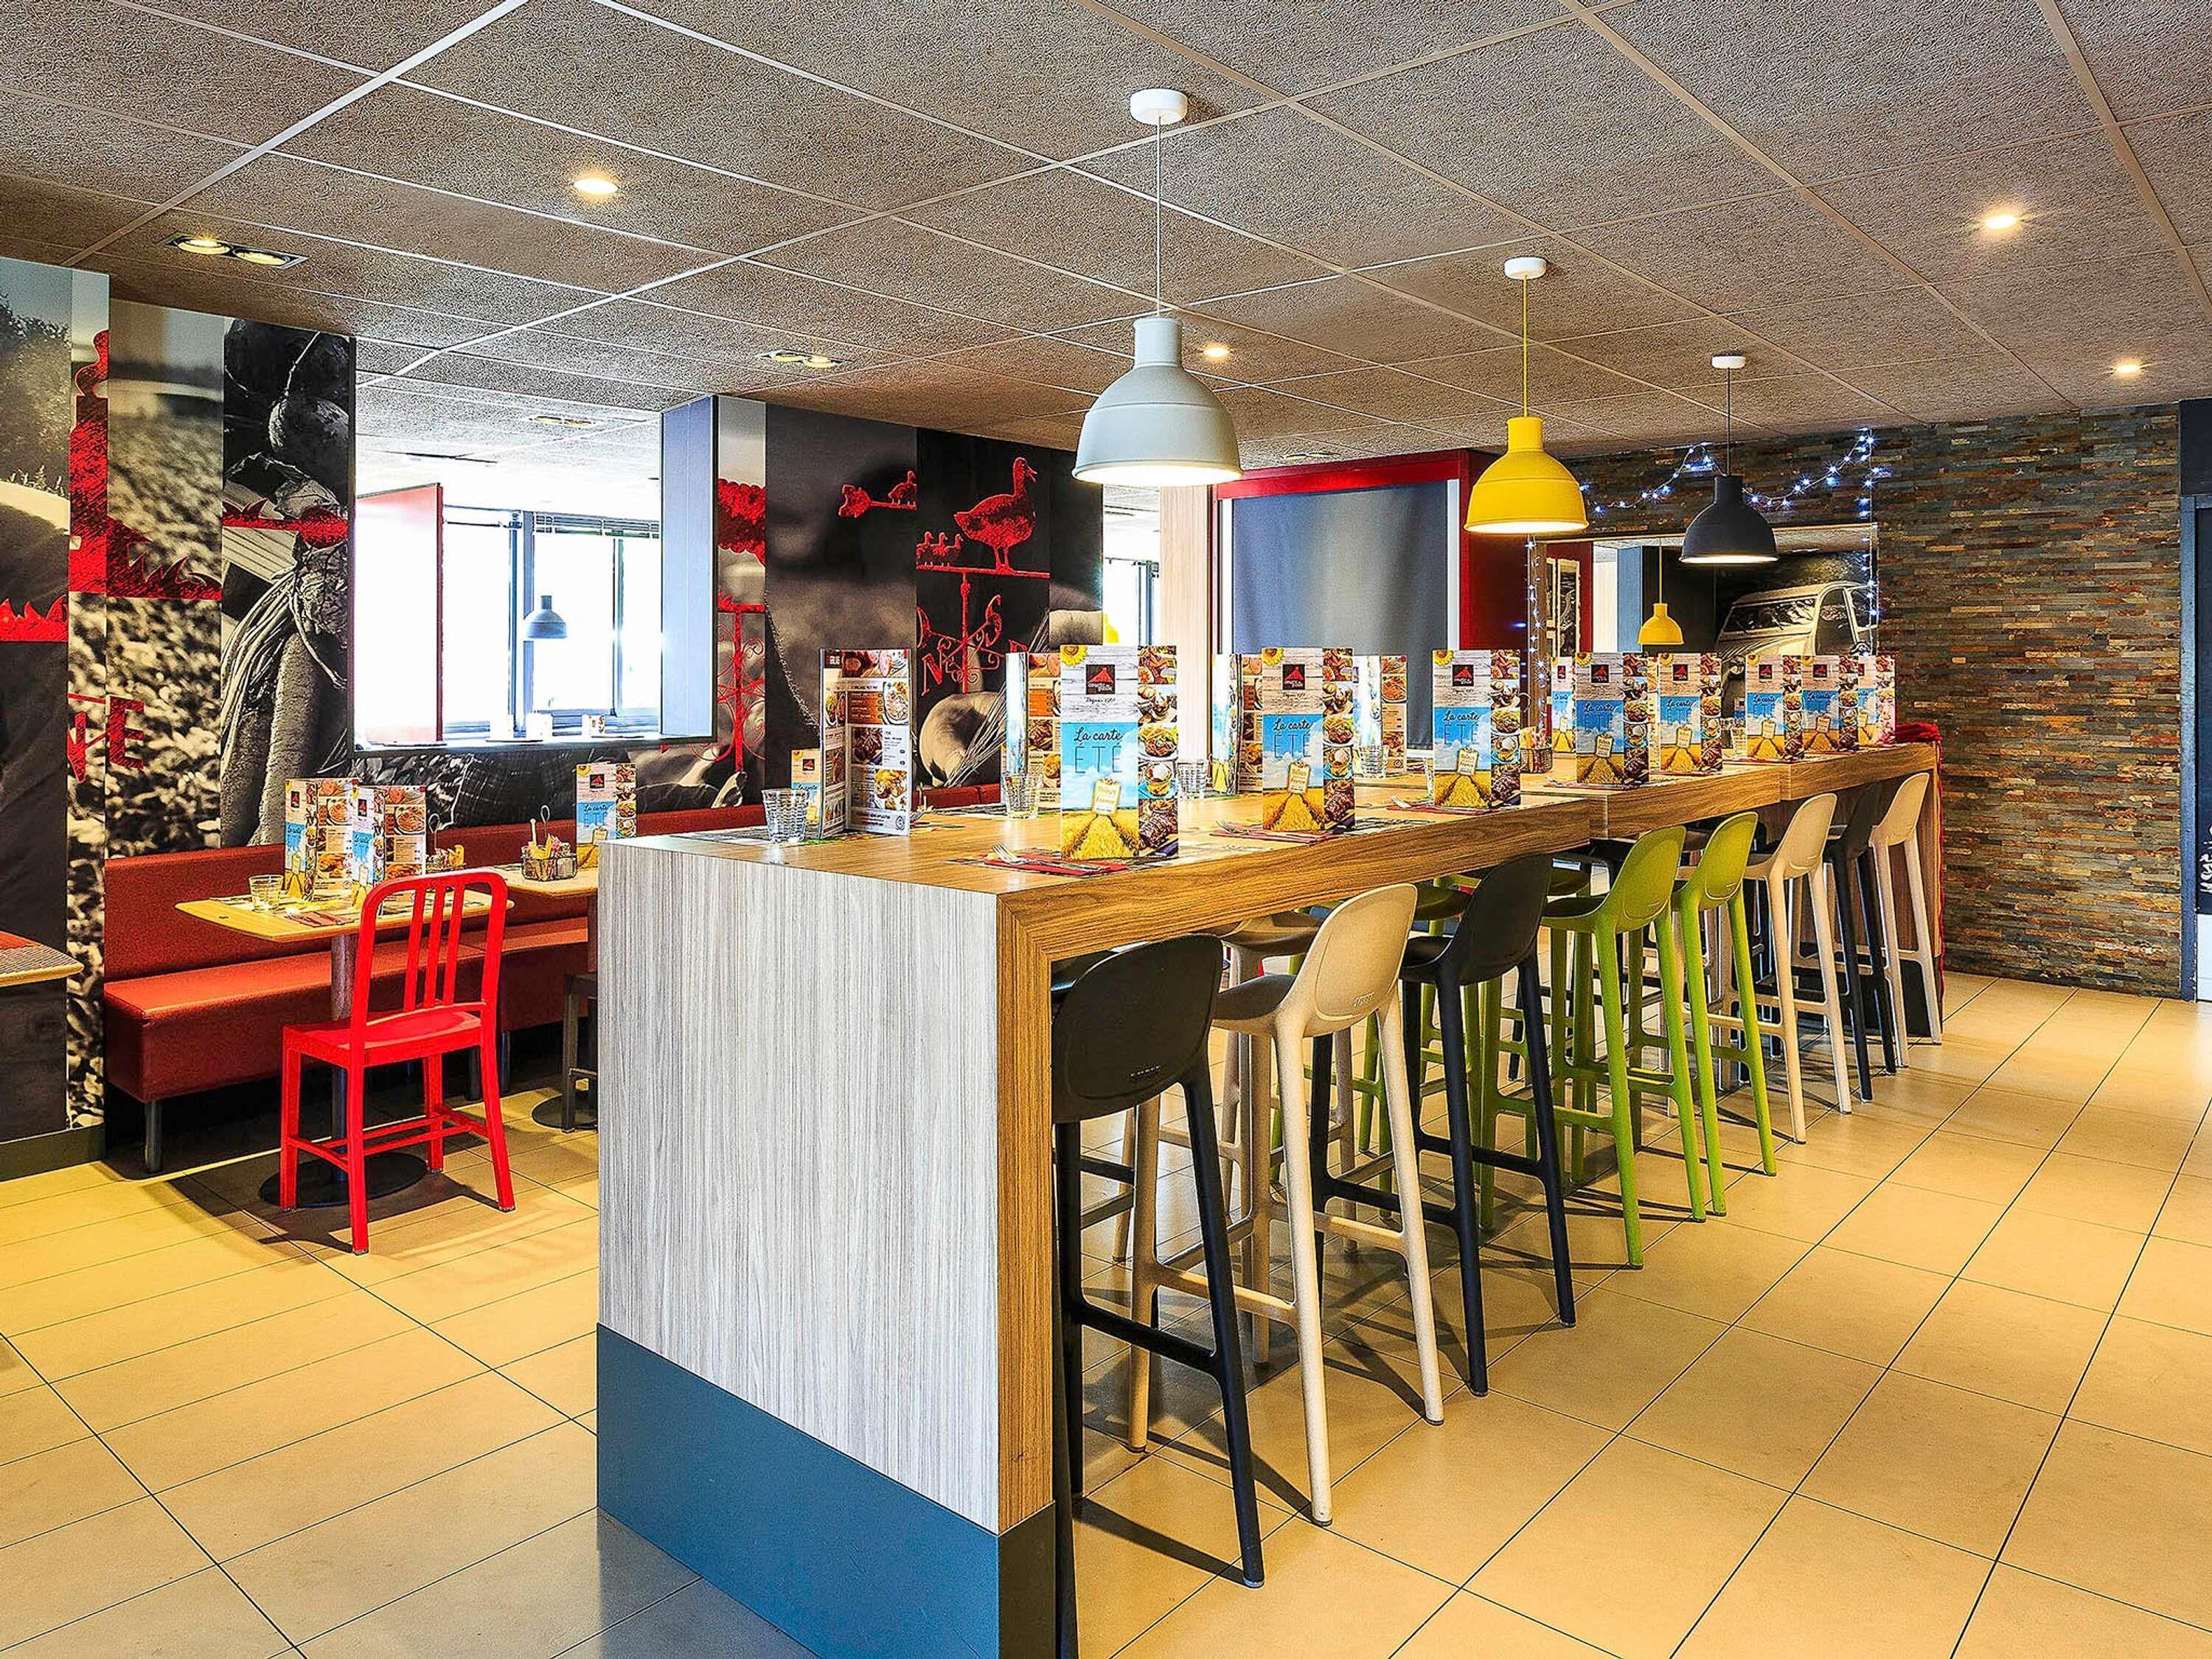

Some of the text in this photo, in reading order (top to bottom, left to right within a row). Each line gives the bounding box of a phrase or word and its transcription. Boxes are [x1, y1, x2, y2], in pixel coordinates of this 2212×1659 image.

[922, 653, 942, 696] N
[1273, 718, 1312, 731] La carte
[1443, 710, 1481, 721] La carte
[108, 695, 145, 770] E
[1074, 726, 1124, 742] La carte
[1274, 731, 1312, 759] ÉTÉ
[1444, 722, 1480, 745] ÉTÉ
[1074, 743, 1123, 774] ÉTÉ
